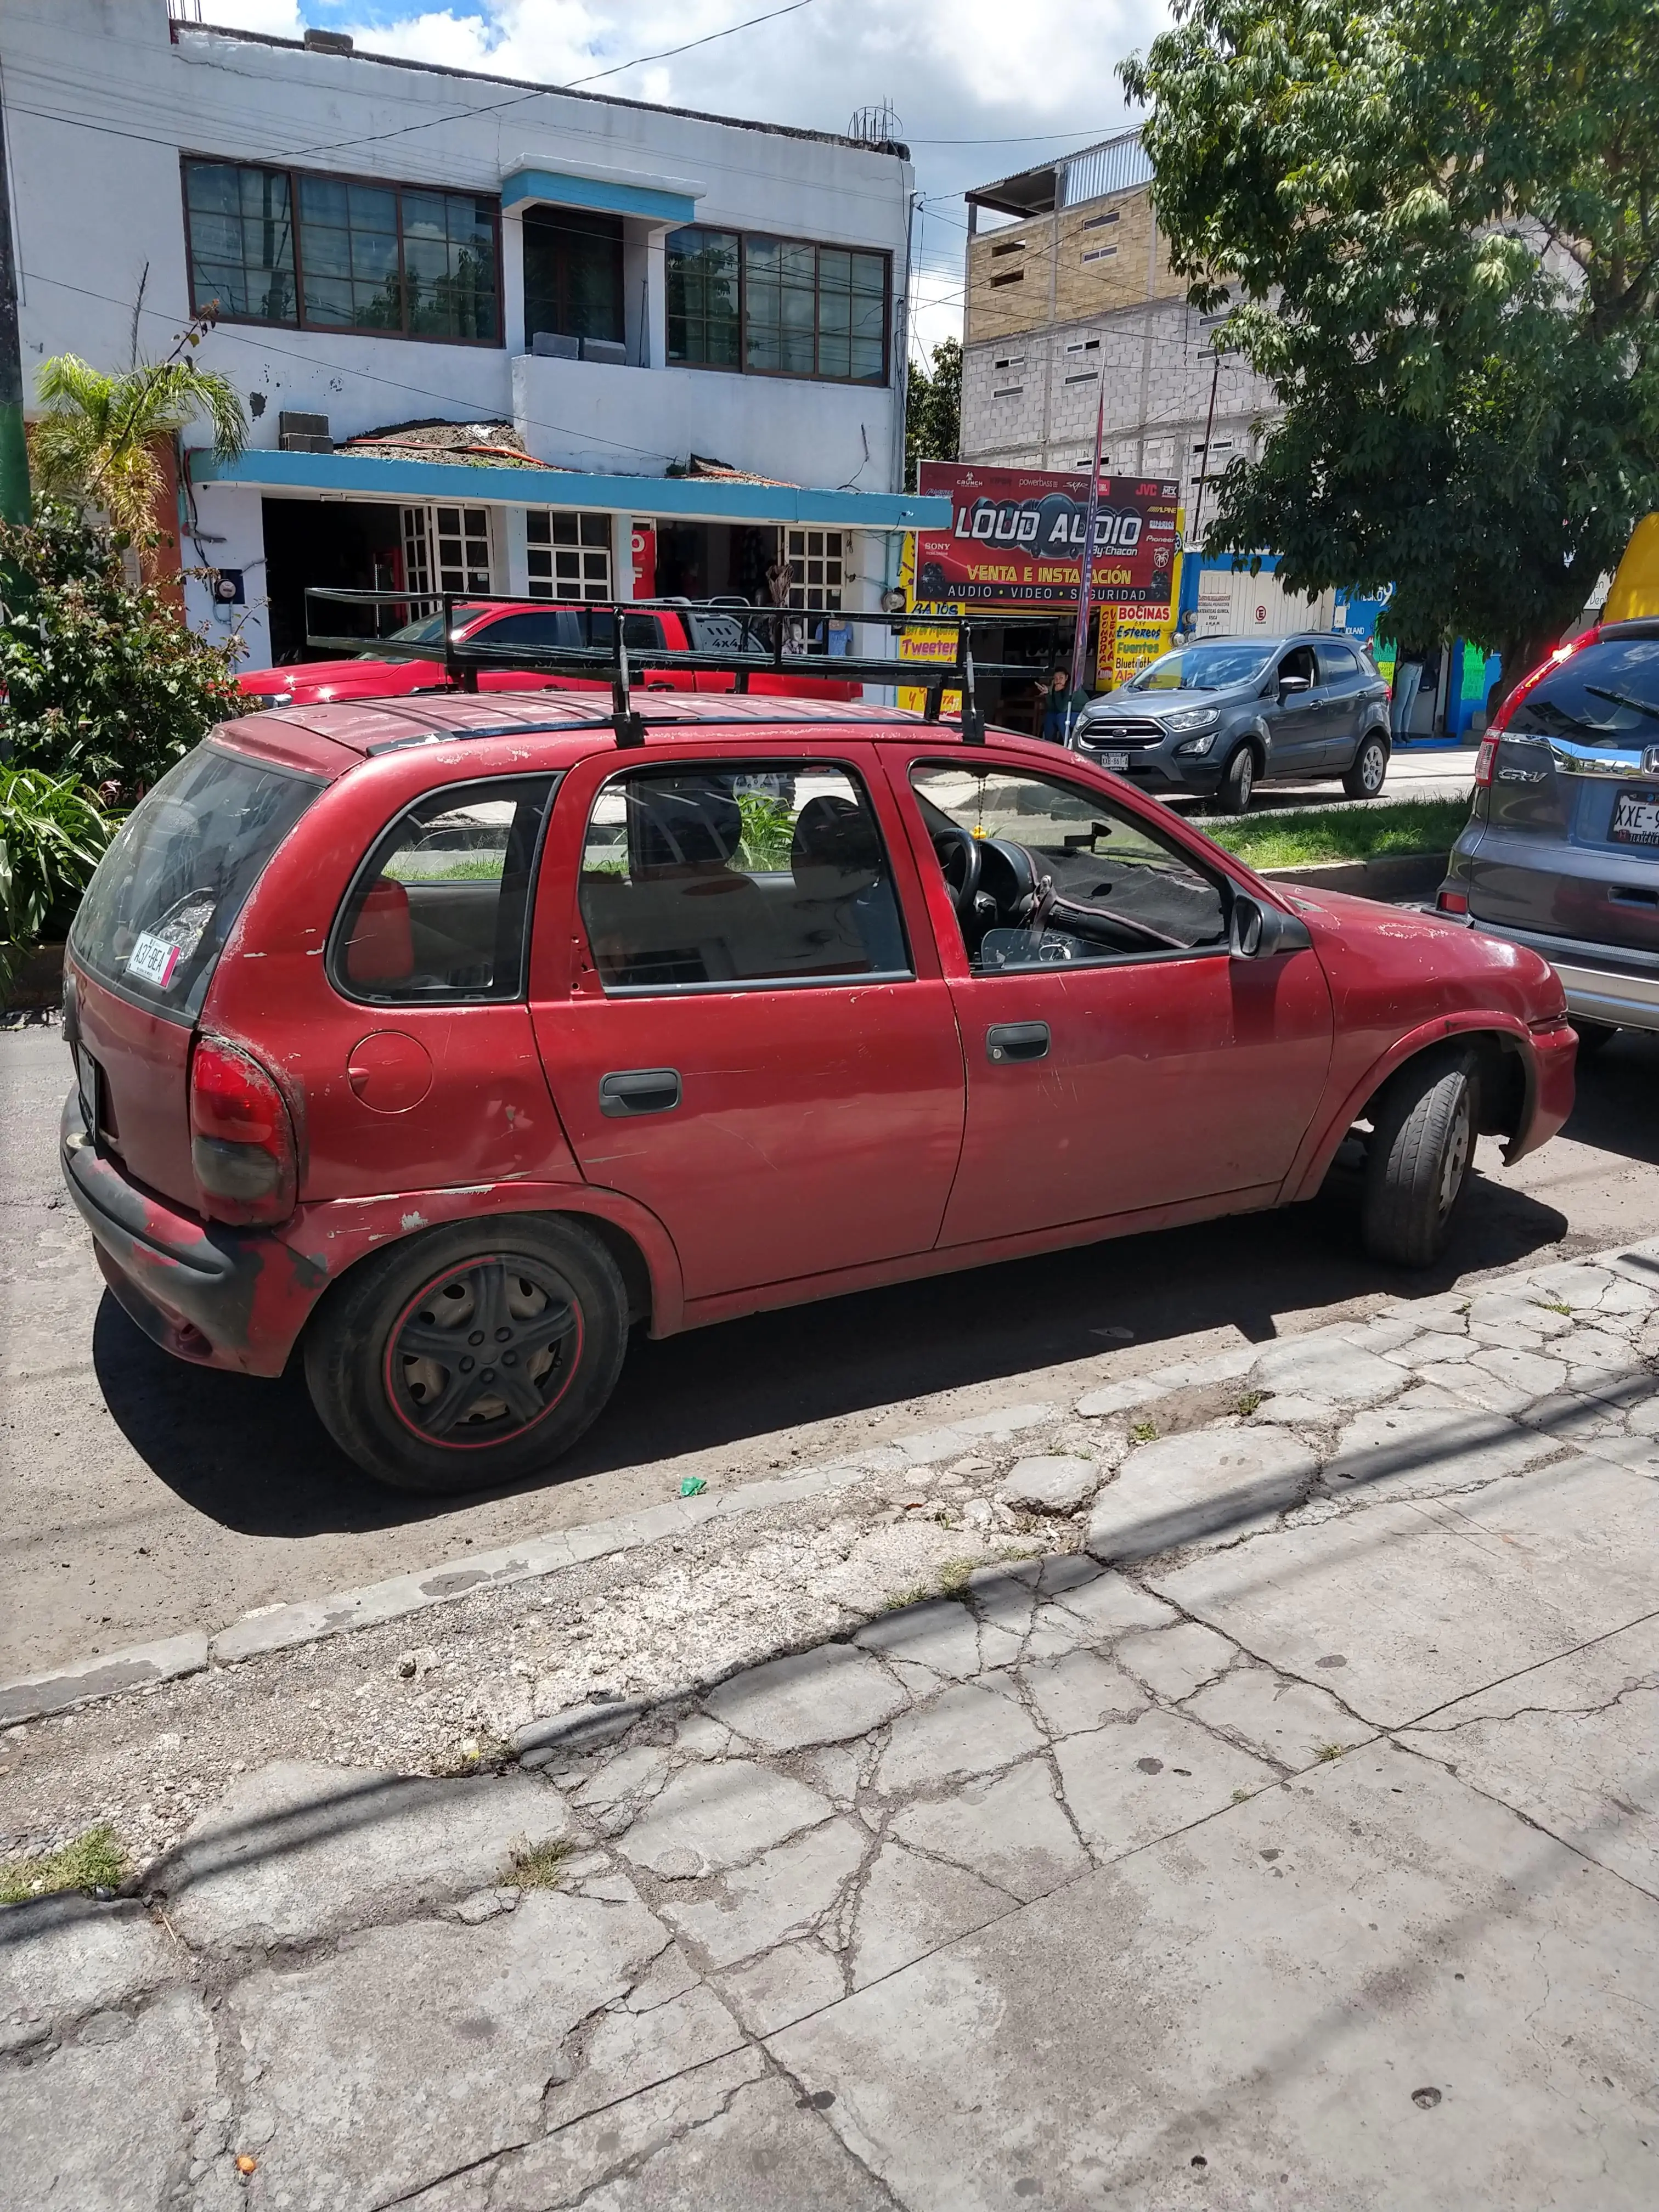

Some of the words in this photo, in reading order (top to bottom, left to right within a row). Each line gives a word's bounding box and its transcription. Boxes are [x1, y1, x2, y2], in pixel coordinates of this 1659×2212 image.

[1135, 483, 1157, 496] JVC
[1161, 486, 1177, 495] MTX
[955, 507, 1040, 540] LOUD
[1048, 514, 1142, 545] AUDIO
[967, 565, 1017, 582] VENTA
[1023, 567, 1033, 582] E
[1038, 565, 1131, 584] INSTAACIÓN
[947, 585, 992, 598] AUDIO
[1011, 587, 1052, 600] VIDEO
[1070, 588, 1146, 601] SGURIDAD
[1119, 607, 1170, 620] BOCINAS
[1099, 611, 1109, 664] COMPRA
[1107, 608, 1116, 661] VENTA
[1117, 642, 1159, 654] Fuentes
[133, 943, 166, 973] A37-BEA
